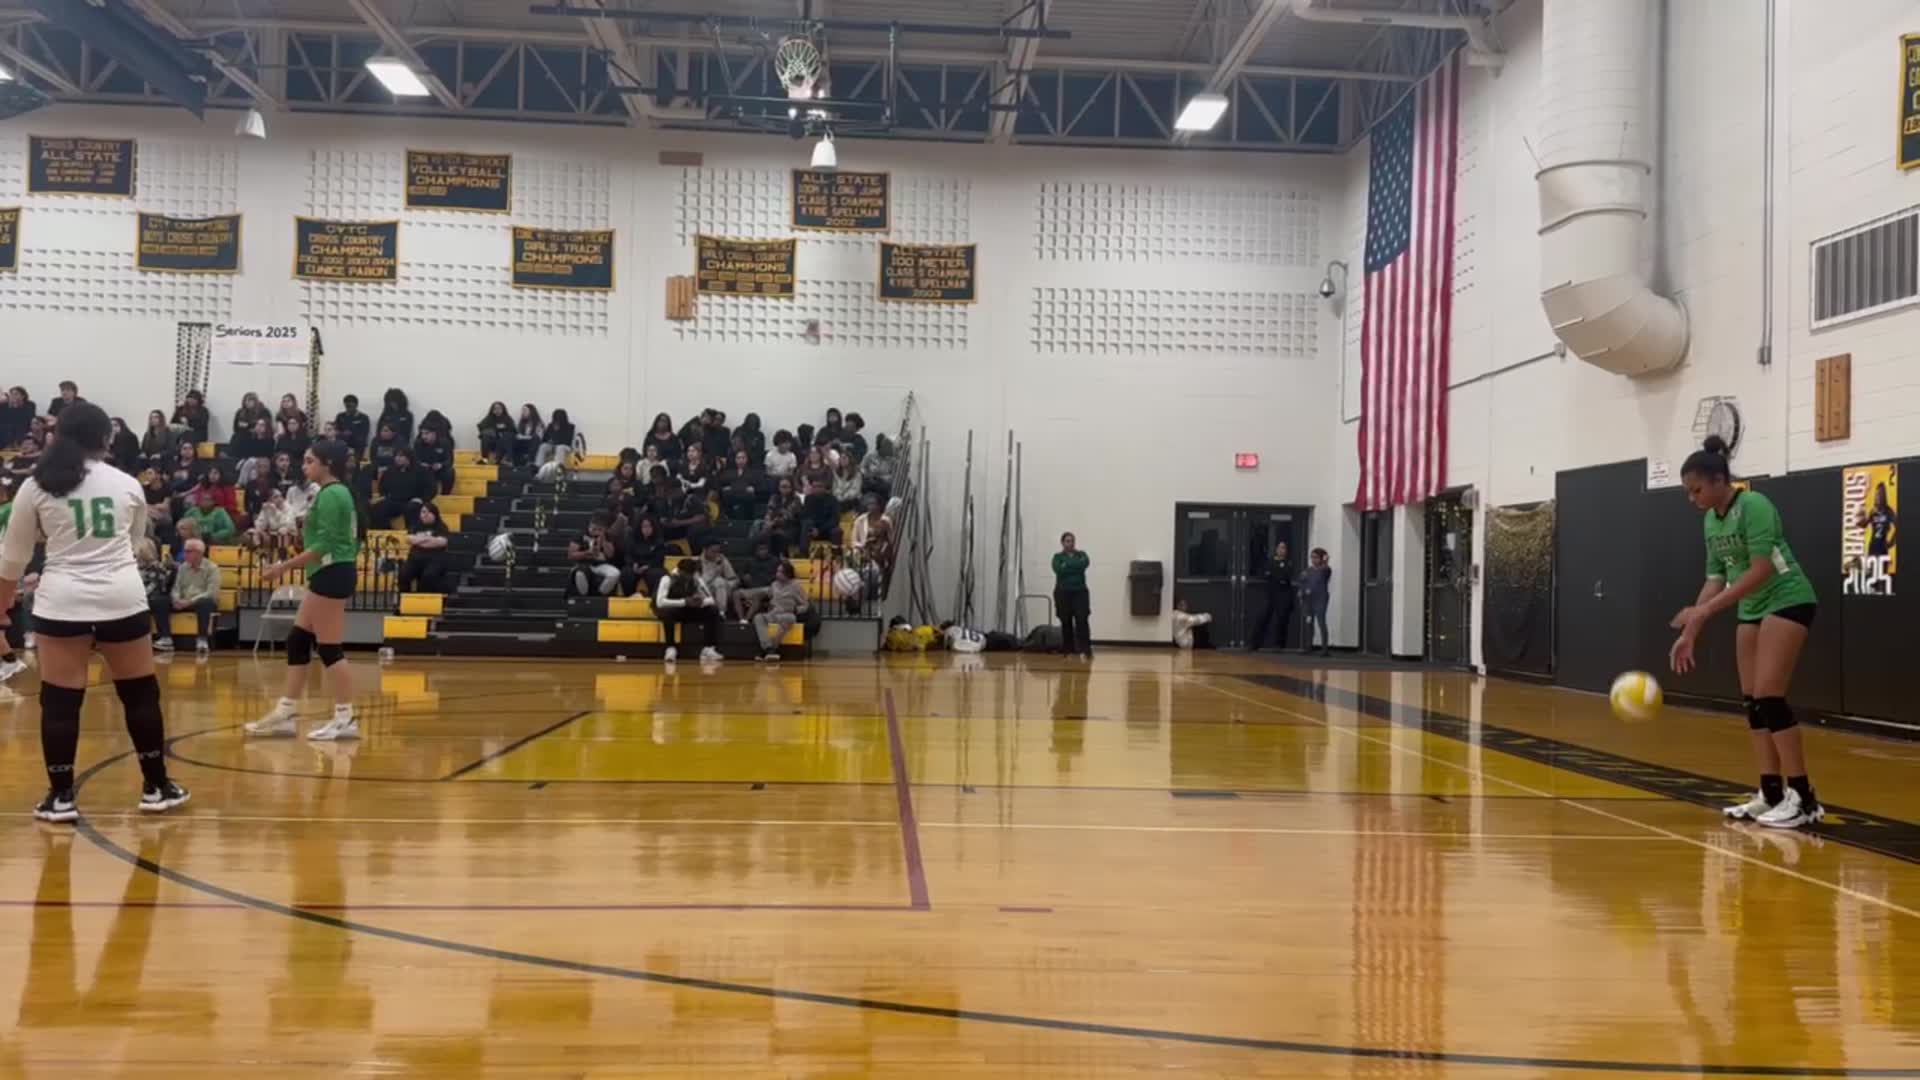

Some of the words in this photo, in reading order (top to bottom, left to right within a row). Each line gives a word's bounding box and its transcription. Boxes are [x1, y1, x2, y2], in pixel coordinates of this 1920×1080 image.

[410, 164, 506, 179] VOLLEYBALL
[415, 175, 500, 190] CHAMPIONS
[310, 244, 385, 258] CHAMPION
[562, 243, 601, 255] TRACK
[521, 251, 603, 265] CHAMPIONS
[919, 257, 967, 269] METER
[706, 259, 787, 273] CHAMPIONS
[216, 324, 262, 338] Seniors
[265, 326, 297, 338] 2025
[68, 497, 115, 540] 16
[1844, 471, 1867, 557] BARROS
[1843, 555, 1892, 595] 2025
